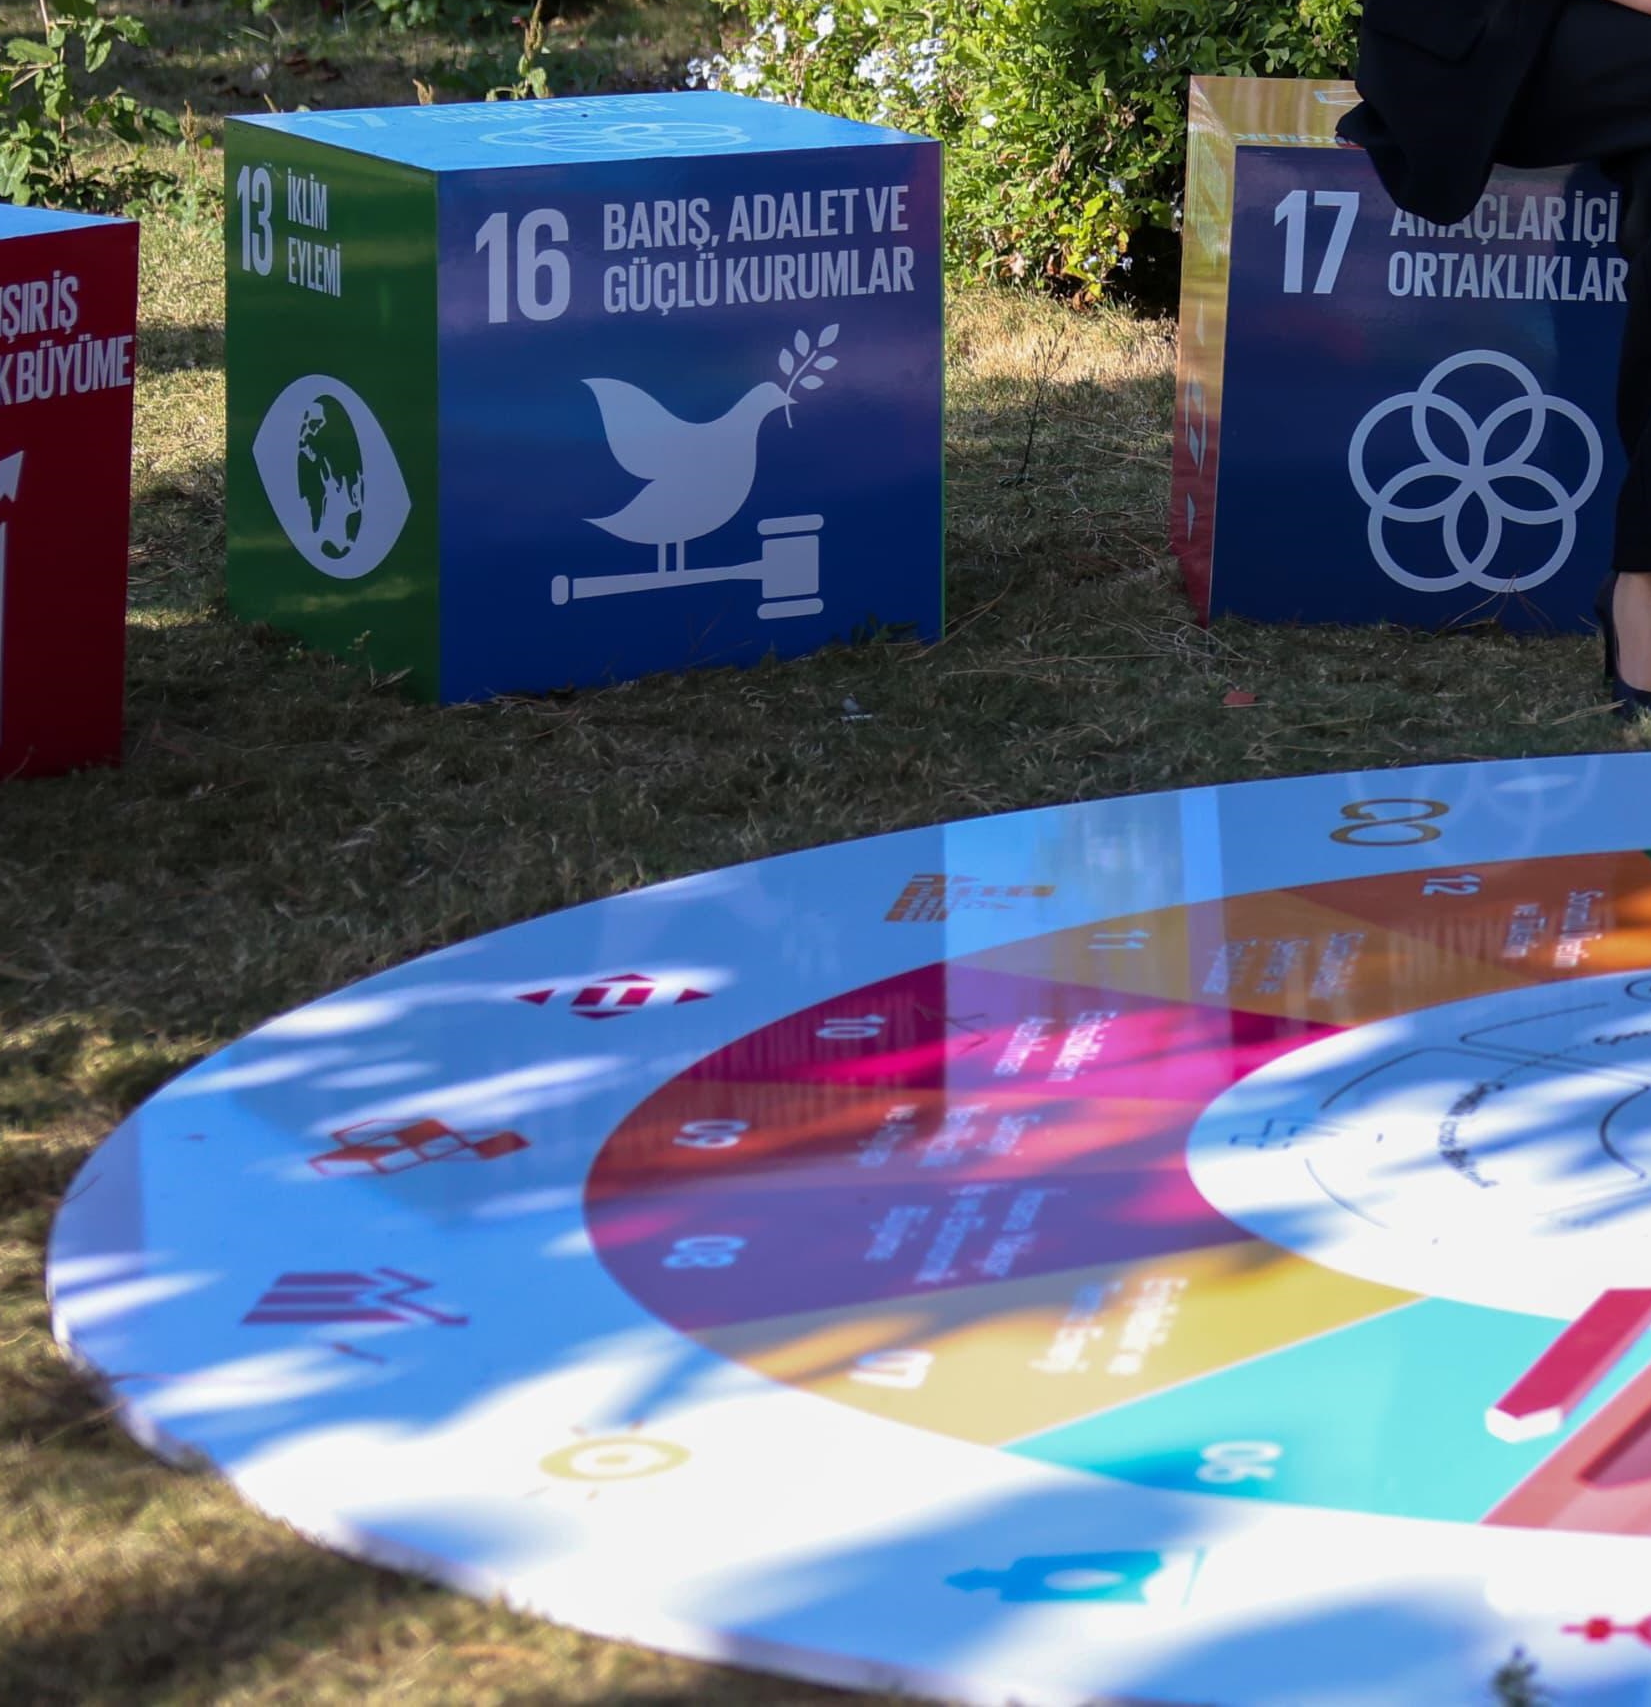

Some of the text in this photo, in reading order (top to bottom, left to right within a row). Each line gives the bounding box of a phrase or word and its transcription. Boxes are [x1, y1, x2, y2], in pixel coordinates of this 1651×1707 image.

[237, 165, 273, 276] 13
[288, 167, 327, 231] İKLİM
[603, 185, 909, 252] BARIŞ, ADALET VE
[288, 236, 341, 297] EYLEMİ
[475, 208, 571, 324] 16
[1274, 190, 1360, 295] 17
[0, 269, 79, 342] ŞIR İŞ
[603, 245, 915, 316] GÜÇLÜ KURUMLAR
[1388, 251, 1629, 302] ORTAKLIKLAR
[17, 333, 133, 403] BÜYÜME
[1422, 874, 1479, 895] 12
[1088, 929, 1149, 949] 11
[816, 1014, 884, 1039] 10
[675, 1121, 745, 1149] 09
[665, 1235, 742, 1267] 08
[851, 1351, 933, 1388] 07
[1197, 1440, 1280, 1483] 06
